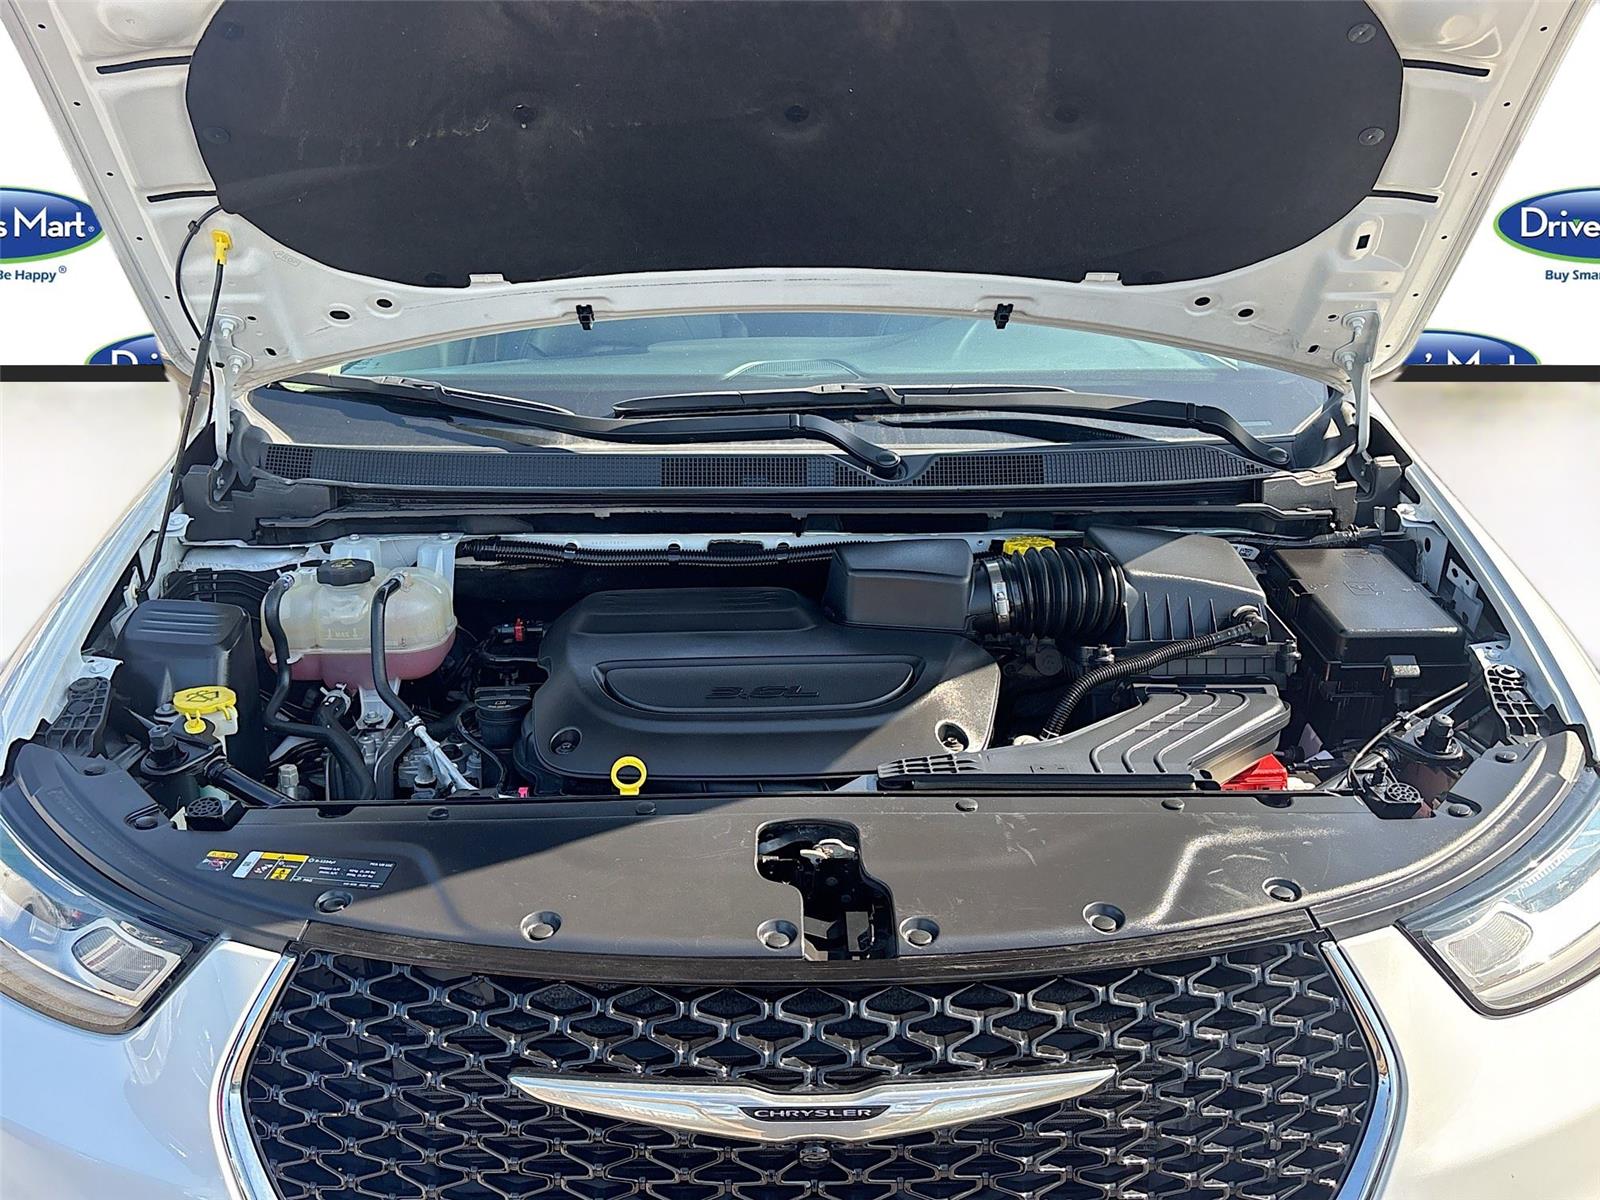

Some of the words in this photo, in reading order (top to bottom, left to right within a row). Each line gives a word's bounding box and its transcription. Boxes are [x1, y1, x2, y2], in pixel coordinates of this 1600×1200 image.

[14, 206, 86, 238] Mart
[1520, 206, 1600, 238] Drive
[15, 269, 57, 283] Happy
[1545, 269, 1570, 283] Buy
[754, 1109, 872, 1118] CHRYSLER
